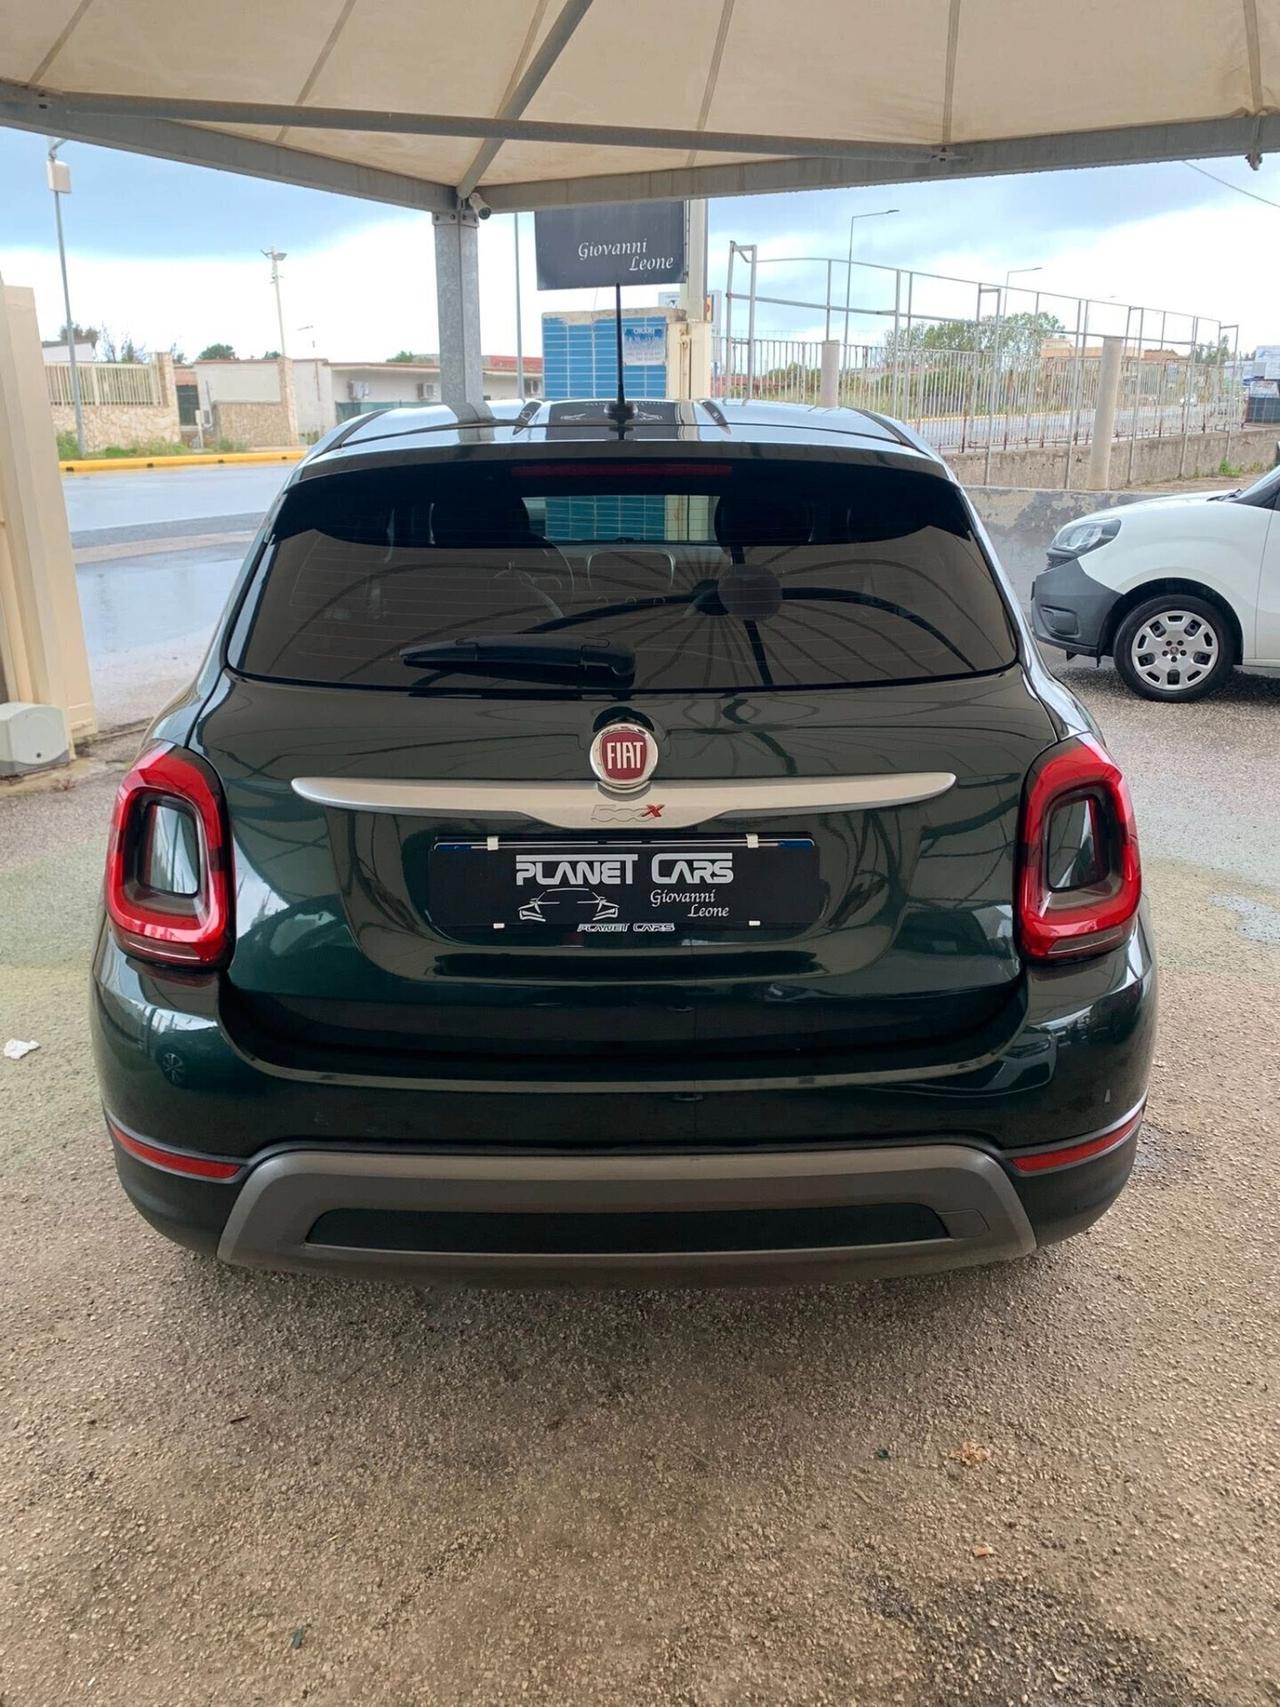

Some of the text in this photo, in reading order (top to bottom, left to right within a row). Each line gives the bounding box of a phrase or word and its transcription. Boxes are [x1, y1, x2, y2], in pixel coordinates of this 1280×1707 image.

[578, 238, 648, 261] Giovanni
[628, 255, 674, 271] Leone
[606, 741, 644, 769] FIAT
[515, 852, 734, 886] PLANET CARS
[650, 889, 716, 908] Giovanni
[687, 903, 730, 917] Leone
[577, 922, 676, 932] PLANET CARS
